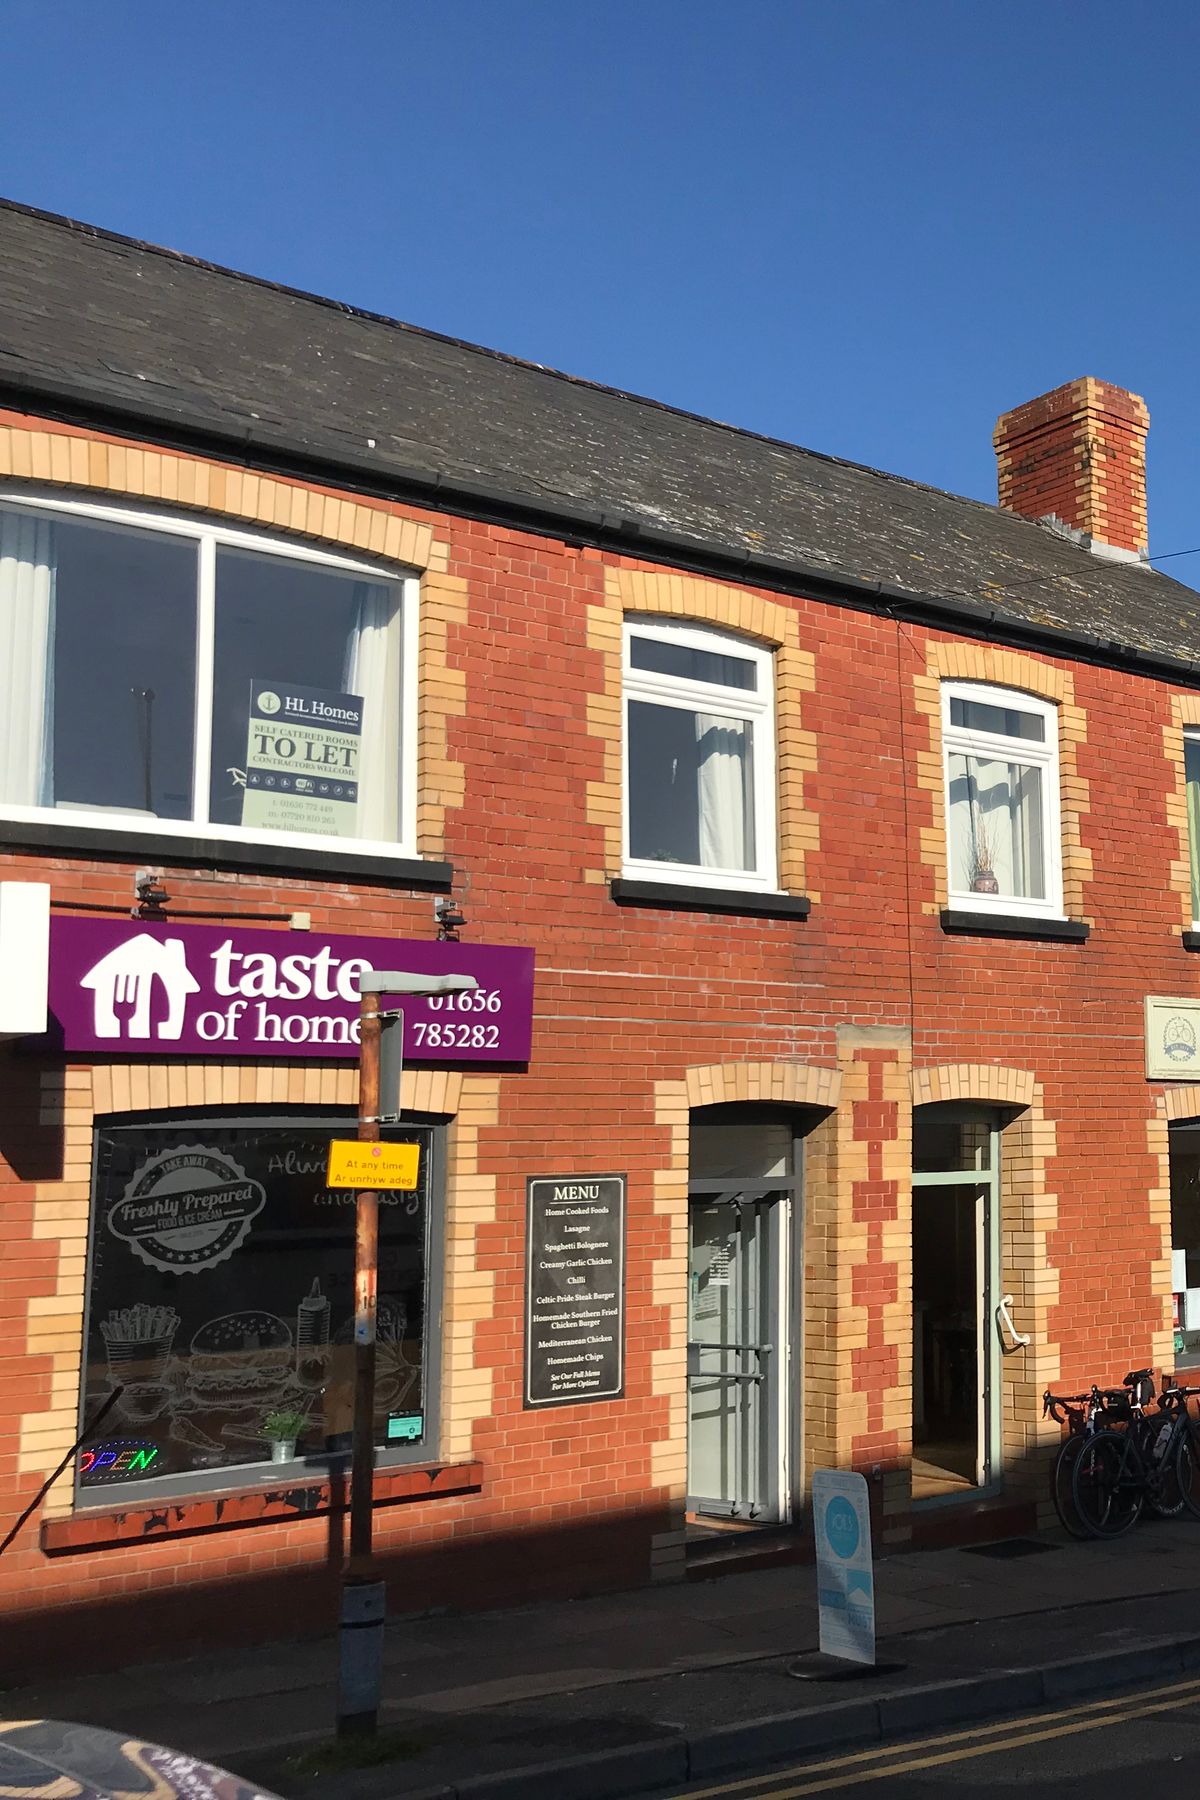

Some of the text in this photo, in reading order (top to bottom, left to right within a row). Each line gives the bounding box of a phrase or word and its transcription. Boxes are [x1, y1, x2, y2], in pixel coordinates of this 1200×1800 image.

[285, 696, 309, 713] HL
[312, 700, 359, 722] Homes
[254, 724, 358, 748] SELF CATERED ROOMS
[254, 733, 358, 768] TO LET
[252, 755, 356, 776] CONTRACTORS WELCOME
[210, 939, 374, 1001] taste
[426, 990, 501, 1013] 01656
[196, 1001, 243, 1042] of
[412, 1022, 500, 1050] 785282
[159, 1156, 210, 1174] TAKE AWAY
[345, 1160, 404, 1171] At any time
[334, 1174, 413, 1186] Ar unrhyw adeg
[553, 1185, 600, 1200] MENU
[120, 1185, 253, 1221] Freshly Prepared
[197, 1208, 224, 1222] CREAM
[545, 1206, 609, 1216] Home Cooked Foods
[563, 1225, 591, 1234] Lasagne
[545, 1241, 609, 1252] Spaghetti Bolognese
[540, 1257, 613, 1269] Creamy Garlic Chicken
[567, 1276, 586, 1285] Chilli
[536, 1292, 615, 1304] Celtic Pride Steak Burger
[533, 1308, 618, 1322] Homemade Southern Fried
[551, 1319, 601, 1330] Chicken Burger
[538, 1335, 613, 1348] Mediterranean Chicken
[547, 1353, 604, 1365] Homemade Chips
[573, 1371, 584, 1379] Full
[552, 1383, 562, 1391] For
[578, 1380, 600, 1389] Options
